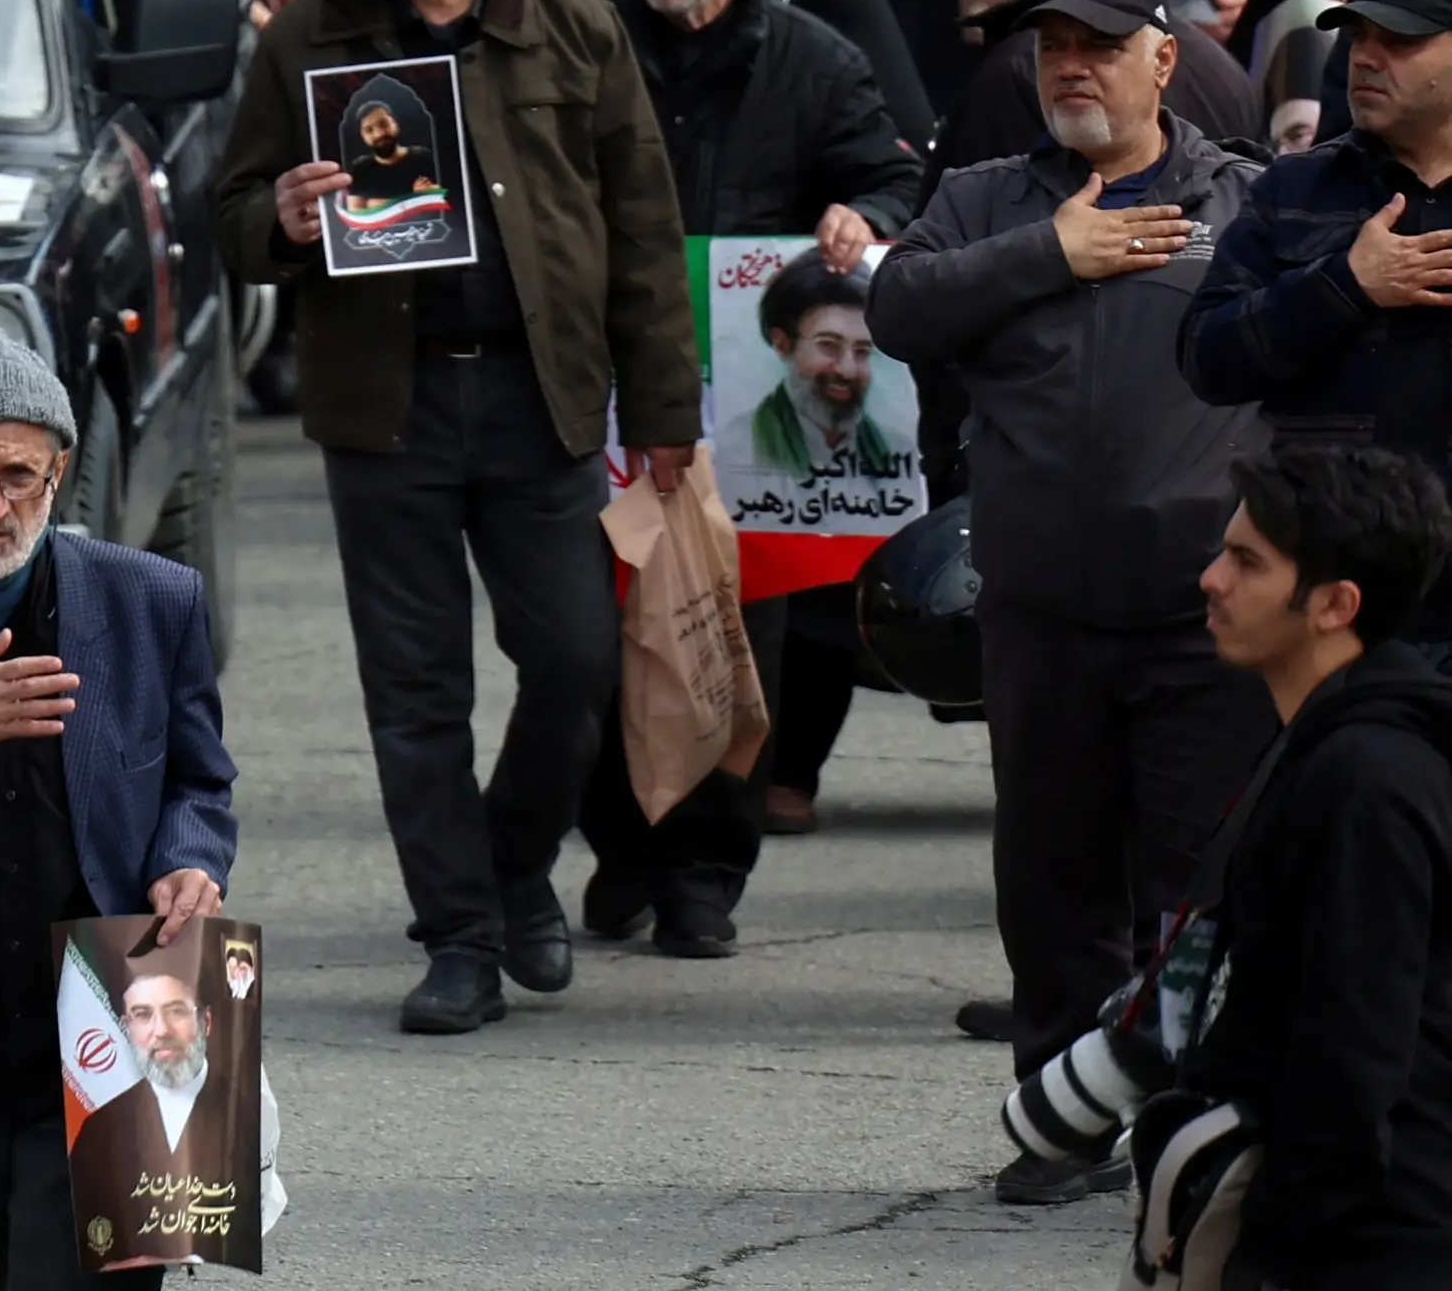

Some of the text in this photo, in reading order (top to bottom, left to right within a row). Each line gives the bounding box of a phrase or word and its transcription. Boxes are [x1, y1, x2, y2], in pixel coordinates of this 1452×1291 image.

[799, 446, 856, 488] اکبر
[731, 490, 795, 525] رهبر
[130, 1172, 236, 1202] دست خدا عیان شد
[137, 1206, 160, 1234] شد
[161, 1209, 196, 1235] جوان
